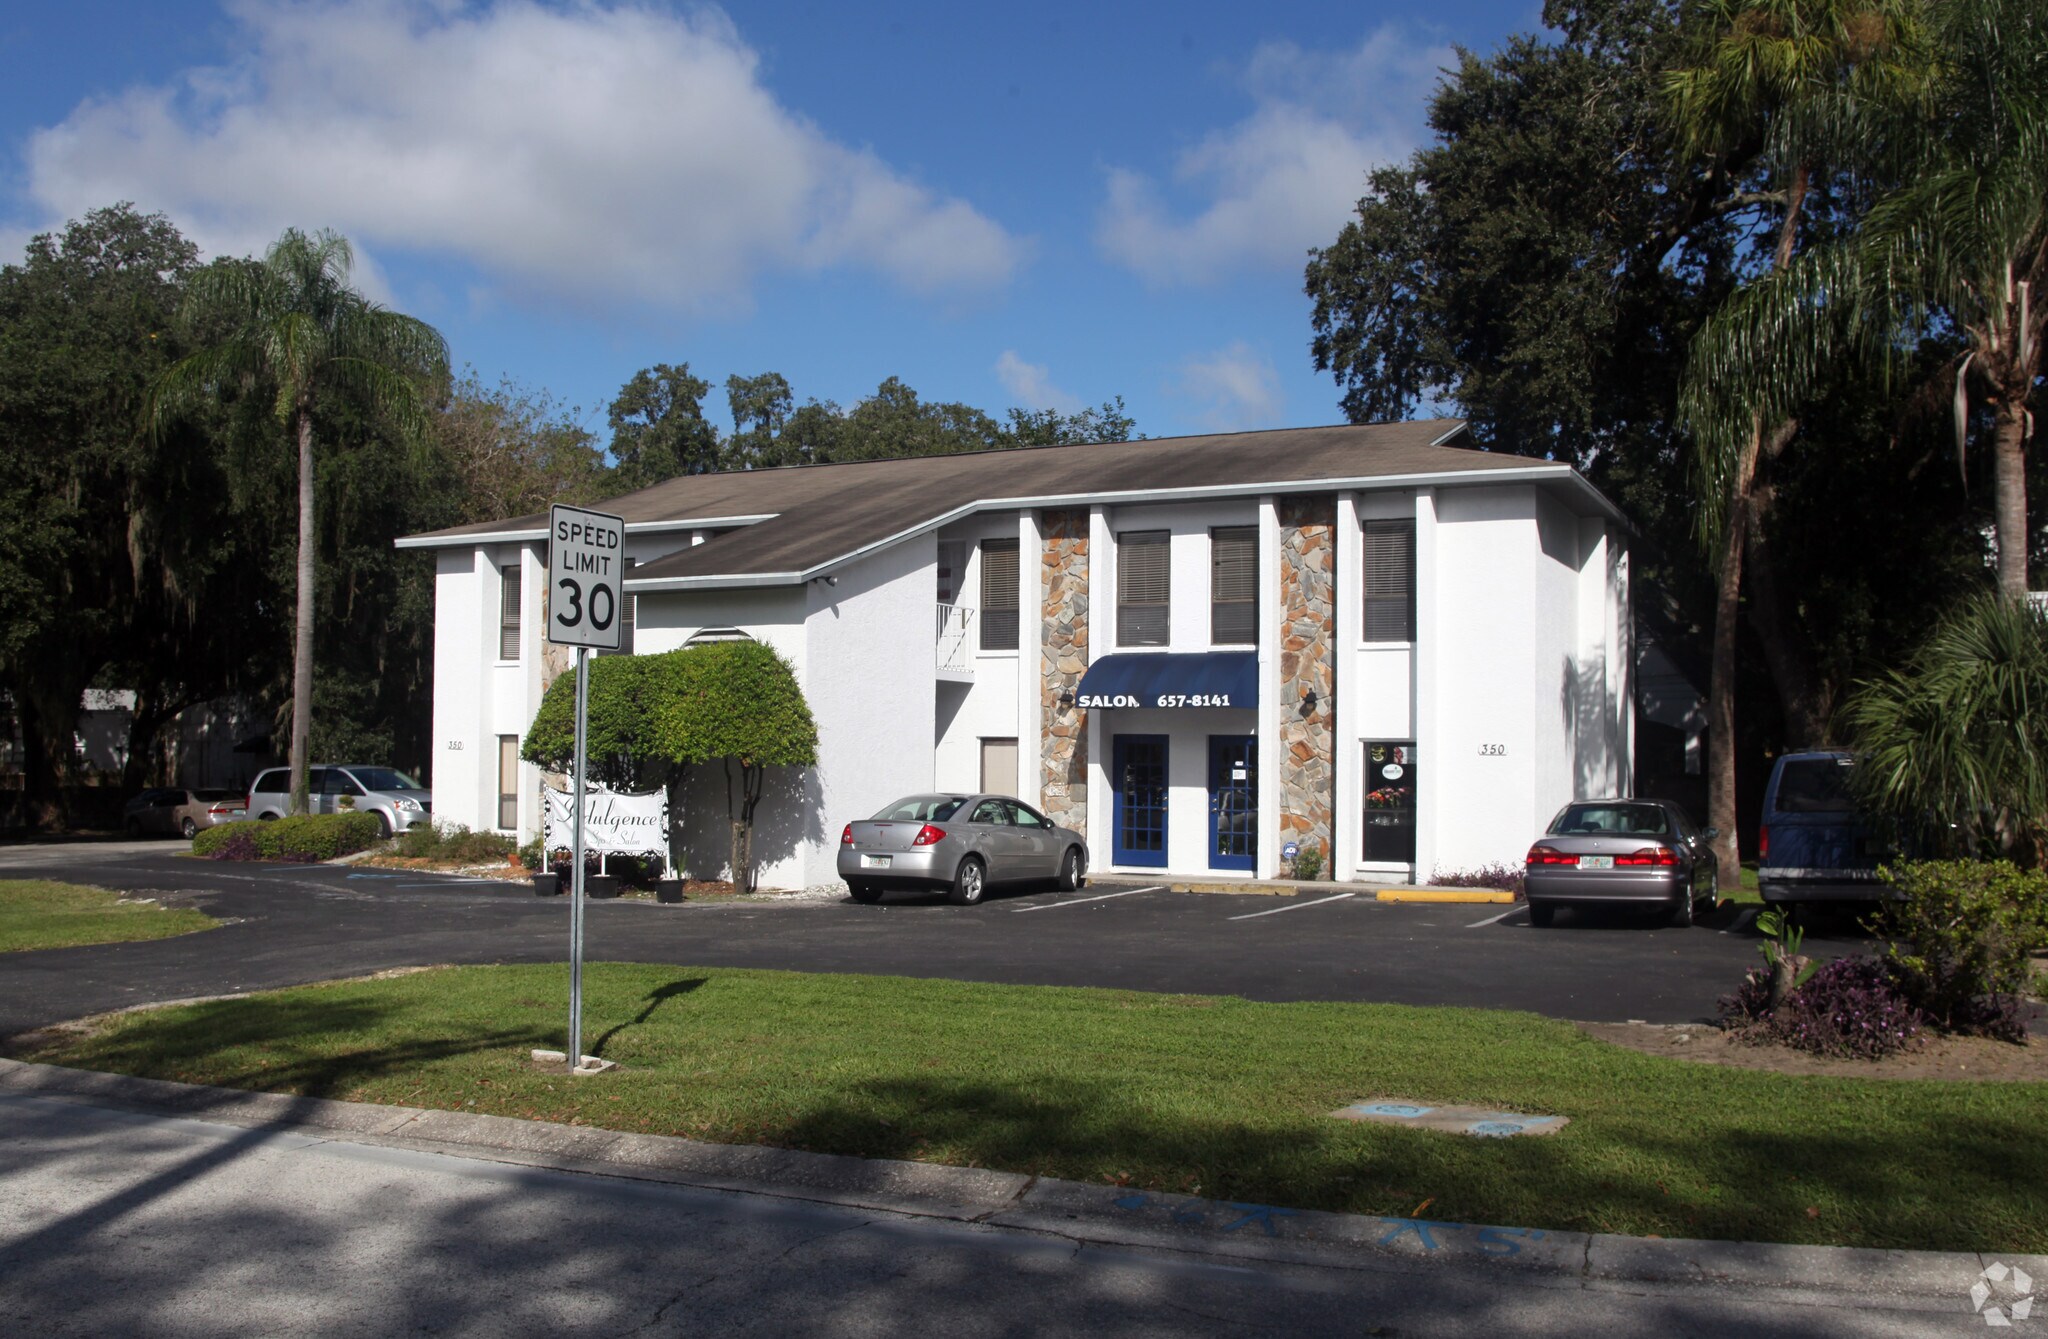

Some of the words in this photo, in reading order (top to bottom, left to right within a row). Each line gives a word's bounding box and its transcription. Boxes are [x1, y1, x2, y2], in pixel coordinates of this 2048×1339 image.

[557, 521, 618, 550] SPEED
[563, 550, 611, 576] LIMIT
[556, 577, 614, 631] 30
[1157, 694, 1230, 708] 657-8141
[1481, 743, 1505, 756] 350
